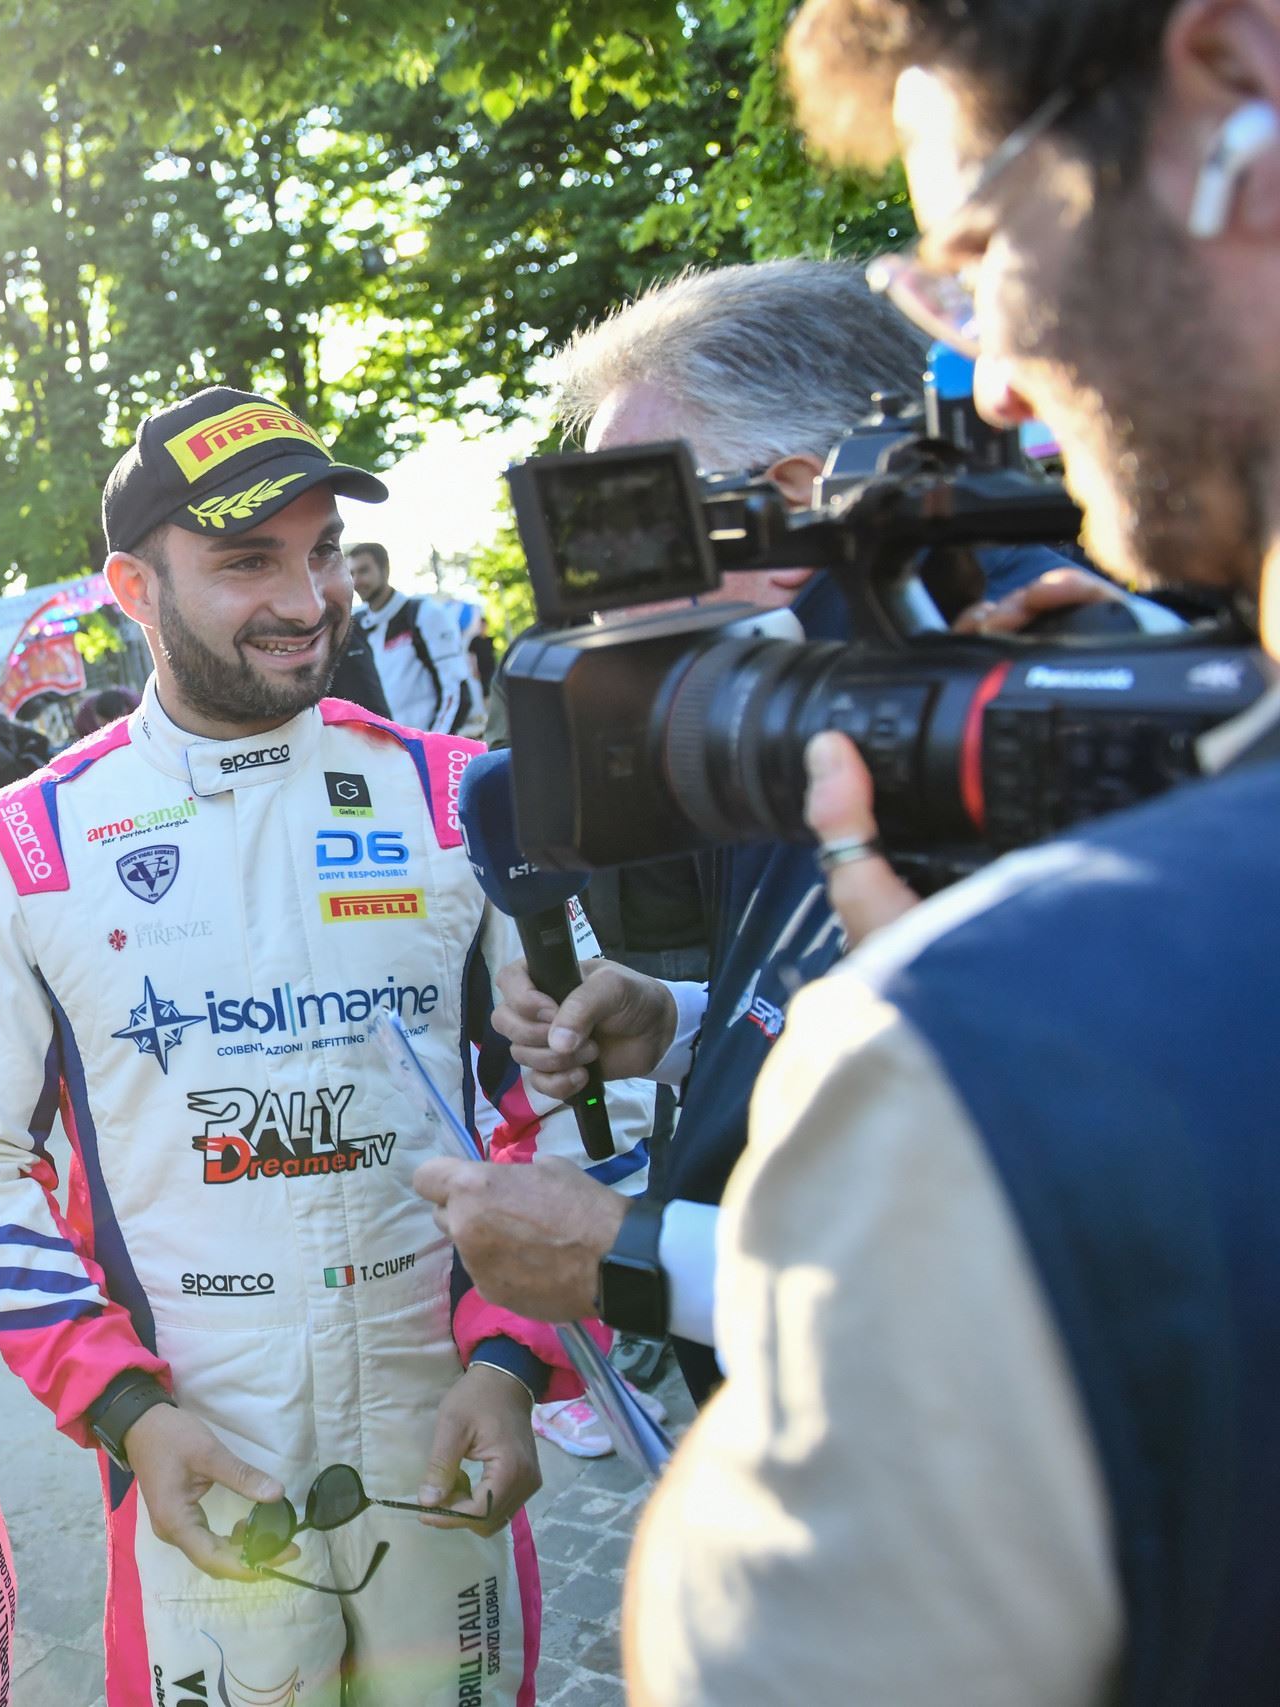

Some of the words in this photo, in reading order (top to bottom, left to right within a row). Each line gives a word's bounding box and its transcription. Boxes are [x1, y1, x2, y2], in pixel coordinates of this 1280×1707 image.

[220, 744, 290, 775] sparco
[0, 802, 52, 885] sparco
[316, 830, 409, 867] D6
[318, 871, 345, 880] DRIVE
[348, 869, 408, 879] RESPONSIBLY
[329, 893, 418, 918] PIRELLI
[136, 920, 214, 949] FIRENZE
[311, 1034, 366, 1050] REFITTING
[360, 1253, 416, 1282] T.CIUFFI
[181, 1272, 276, 1297] sparco
[458, 1583, 482, 1652] ITALIA
[485, 1576, 500, 1630] GLOBALI
[487, 1630, 500, 1676] SERVIZI
